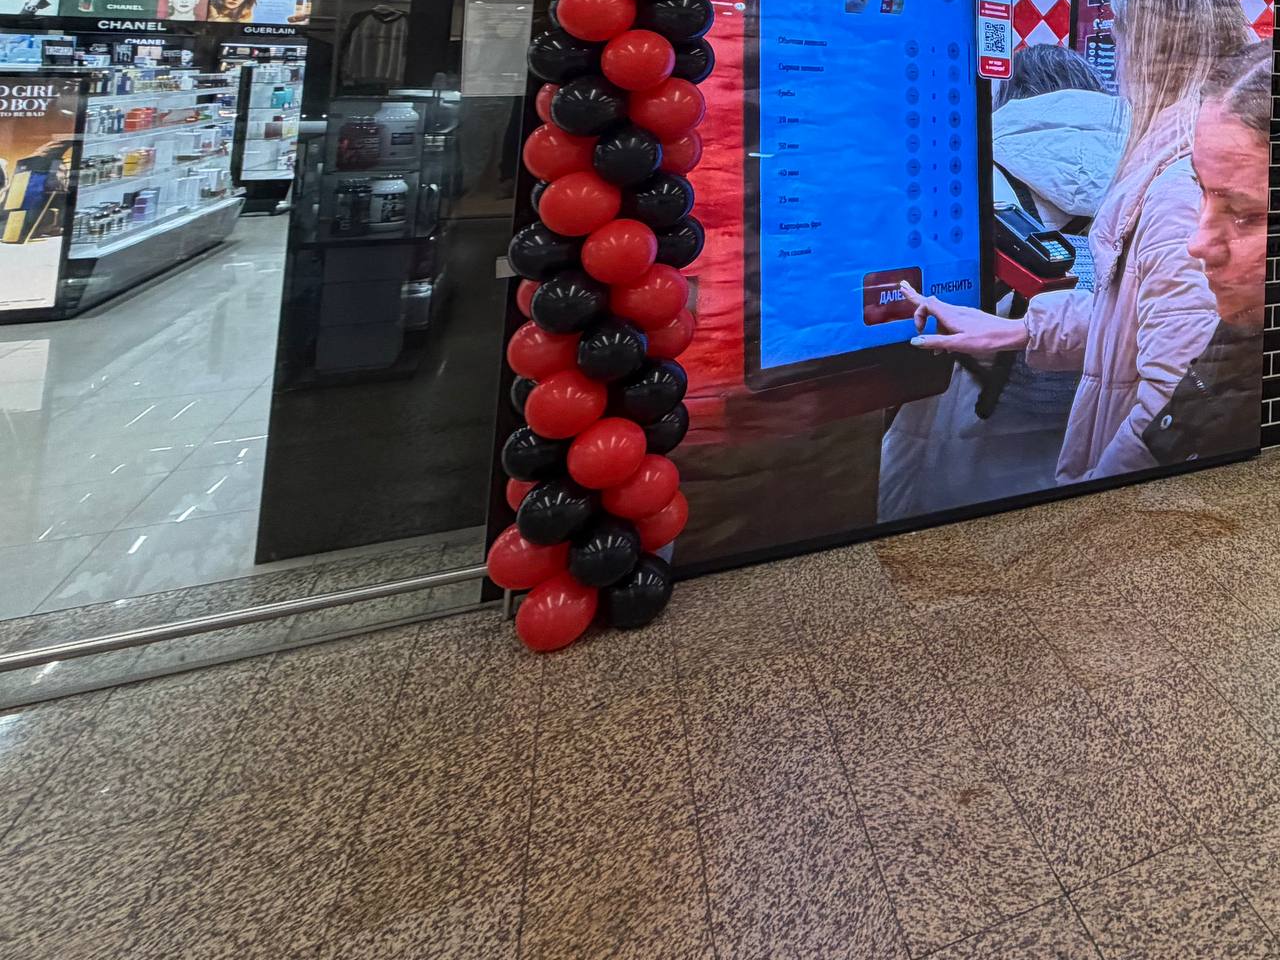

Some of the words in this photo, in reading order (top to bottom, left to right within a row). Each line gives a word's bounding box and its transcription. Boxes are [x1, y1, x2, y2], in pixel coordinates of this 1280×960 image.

[98, 20, 167, 32] CHANEL
[244, 25, 296, 36] GUERLAIN
[12, 85, 61, 97] GIRL
[11, 98, 49, 111] BOY
[930, 278, 973, 295] ОТМЕНИТЬ
